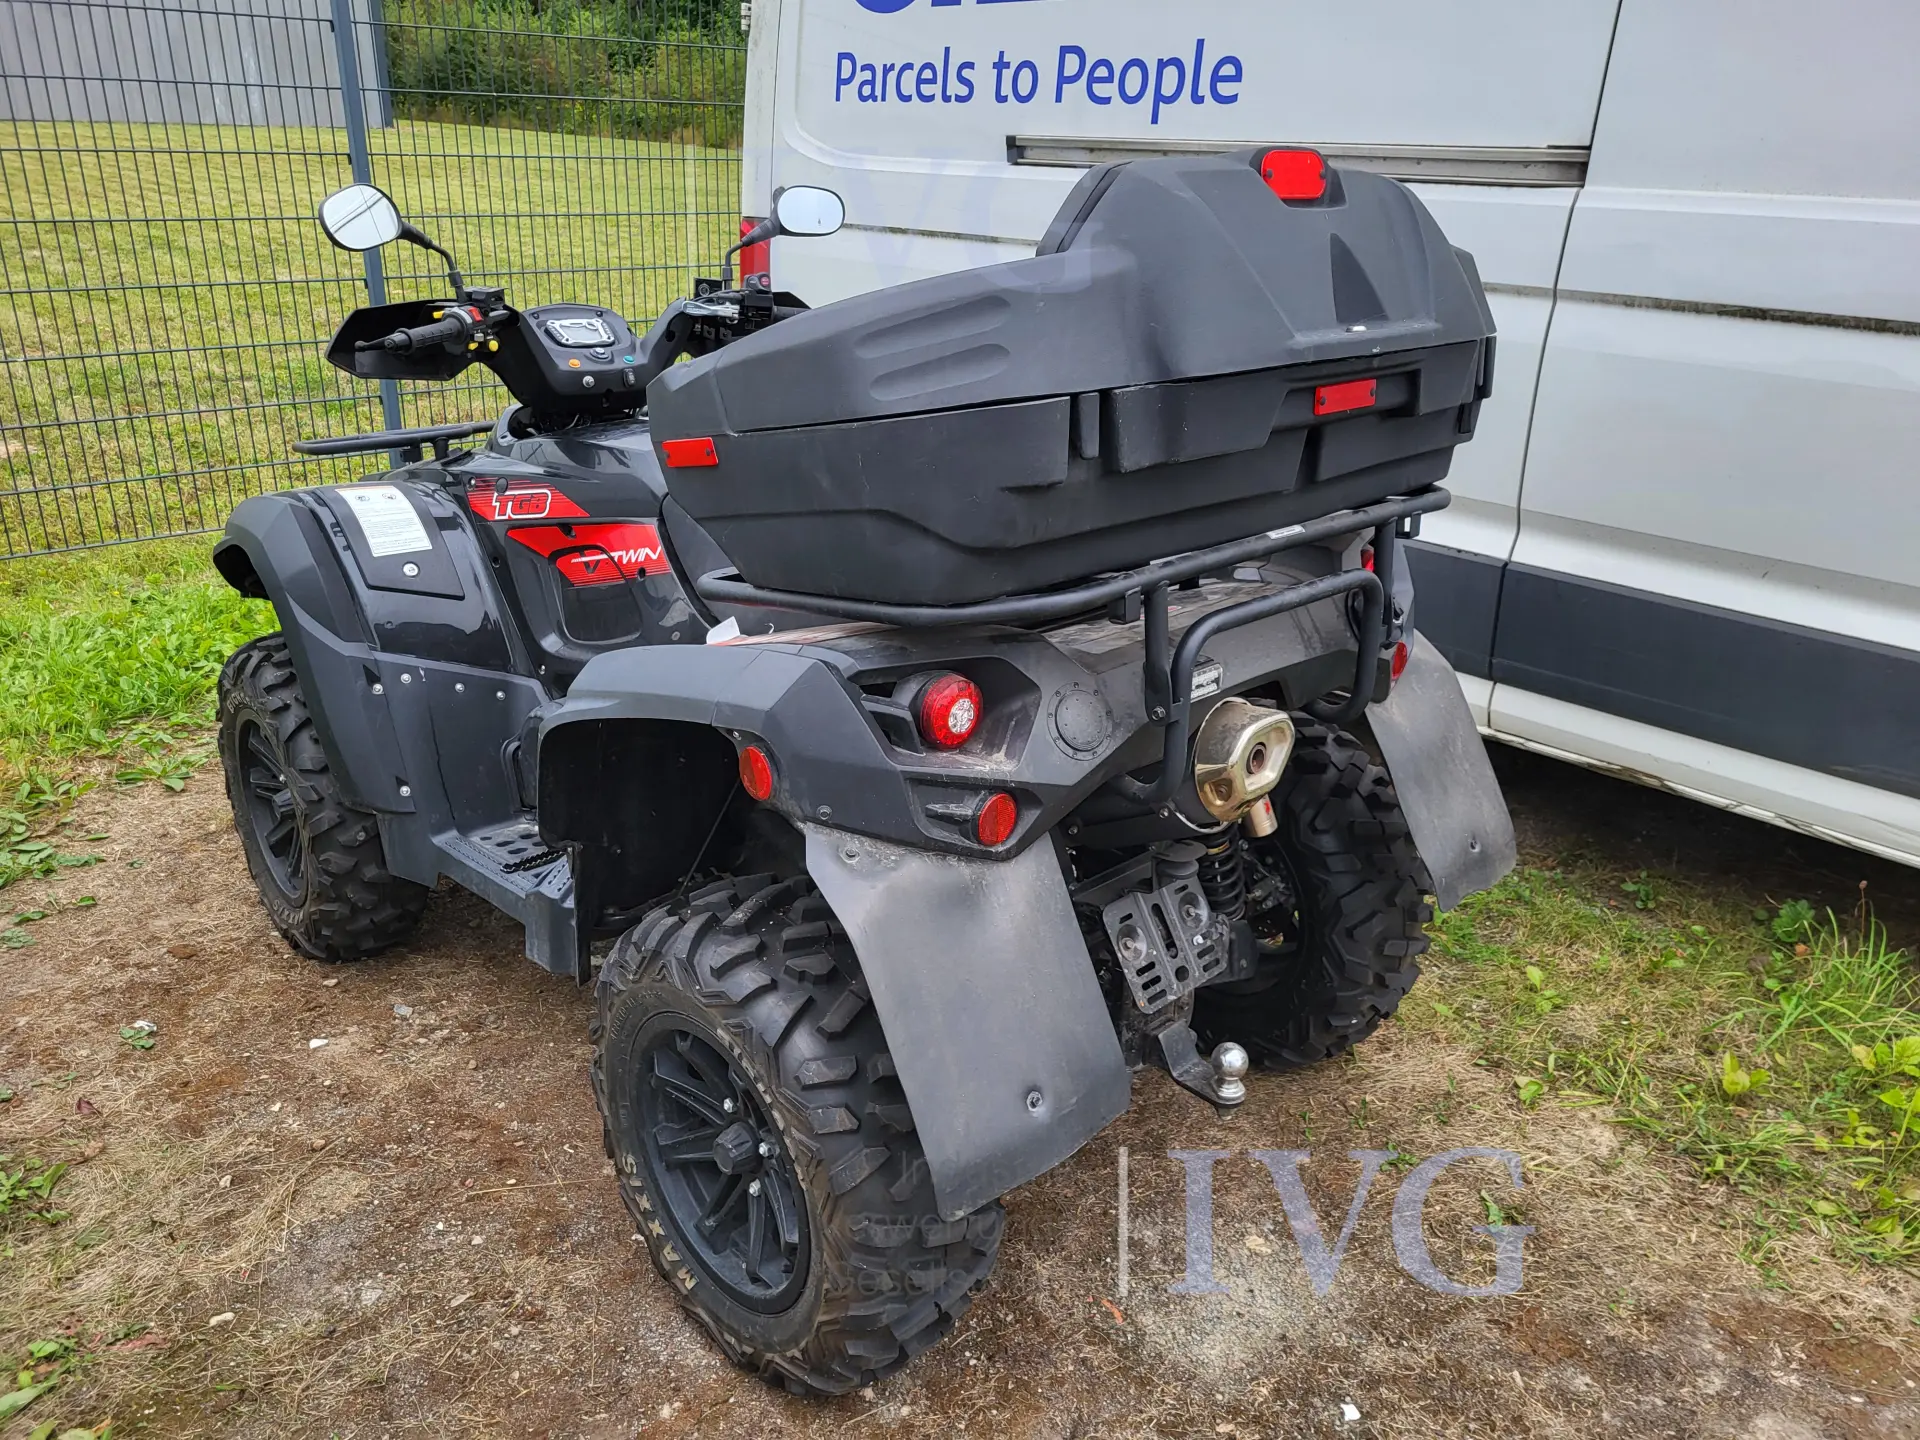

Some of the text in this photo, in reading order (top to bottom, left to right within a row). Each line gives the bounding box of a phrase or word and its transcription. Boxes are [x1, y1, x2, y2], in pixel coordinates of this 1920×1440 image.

[835, 38, 1243, 125] Parcels to People
[492, 489, 551, 519] TGB
